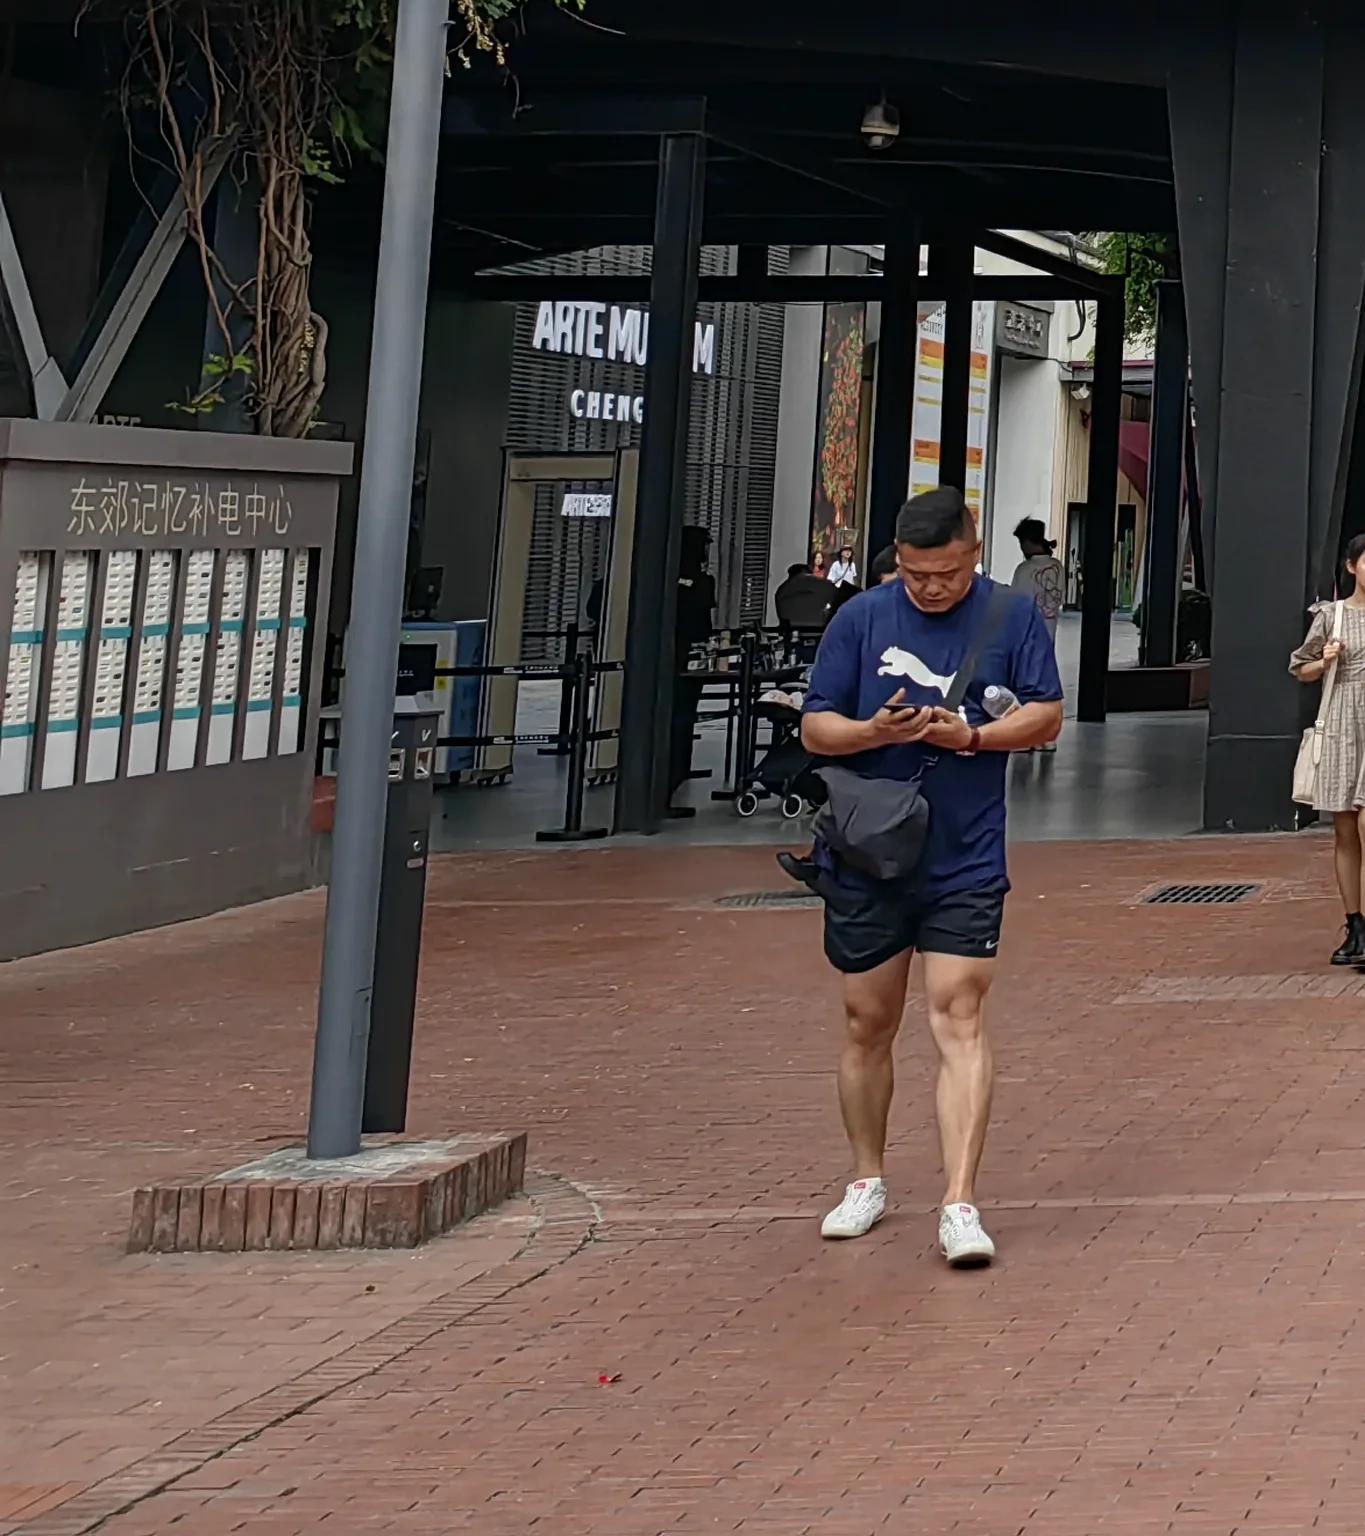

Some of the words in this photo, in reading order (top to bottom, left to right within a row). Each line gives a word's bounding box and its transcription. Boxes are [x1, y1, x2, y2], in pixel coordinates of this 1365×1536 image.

[532, 301, 606, 358] ARTE
[67, 477, 292, 536] 东郊记忆补电中心
